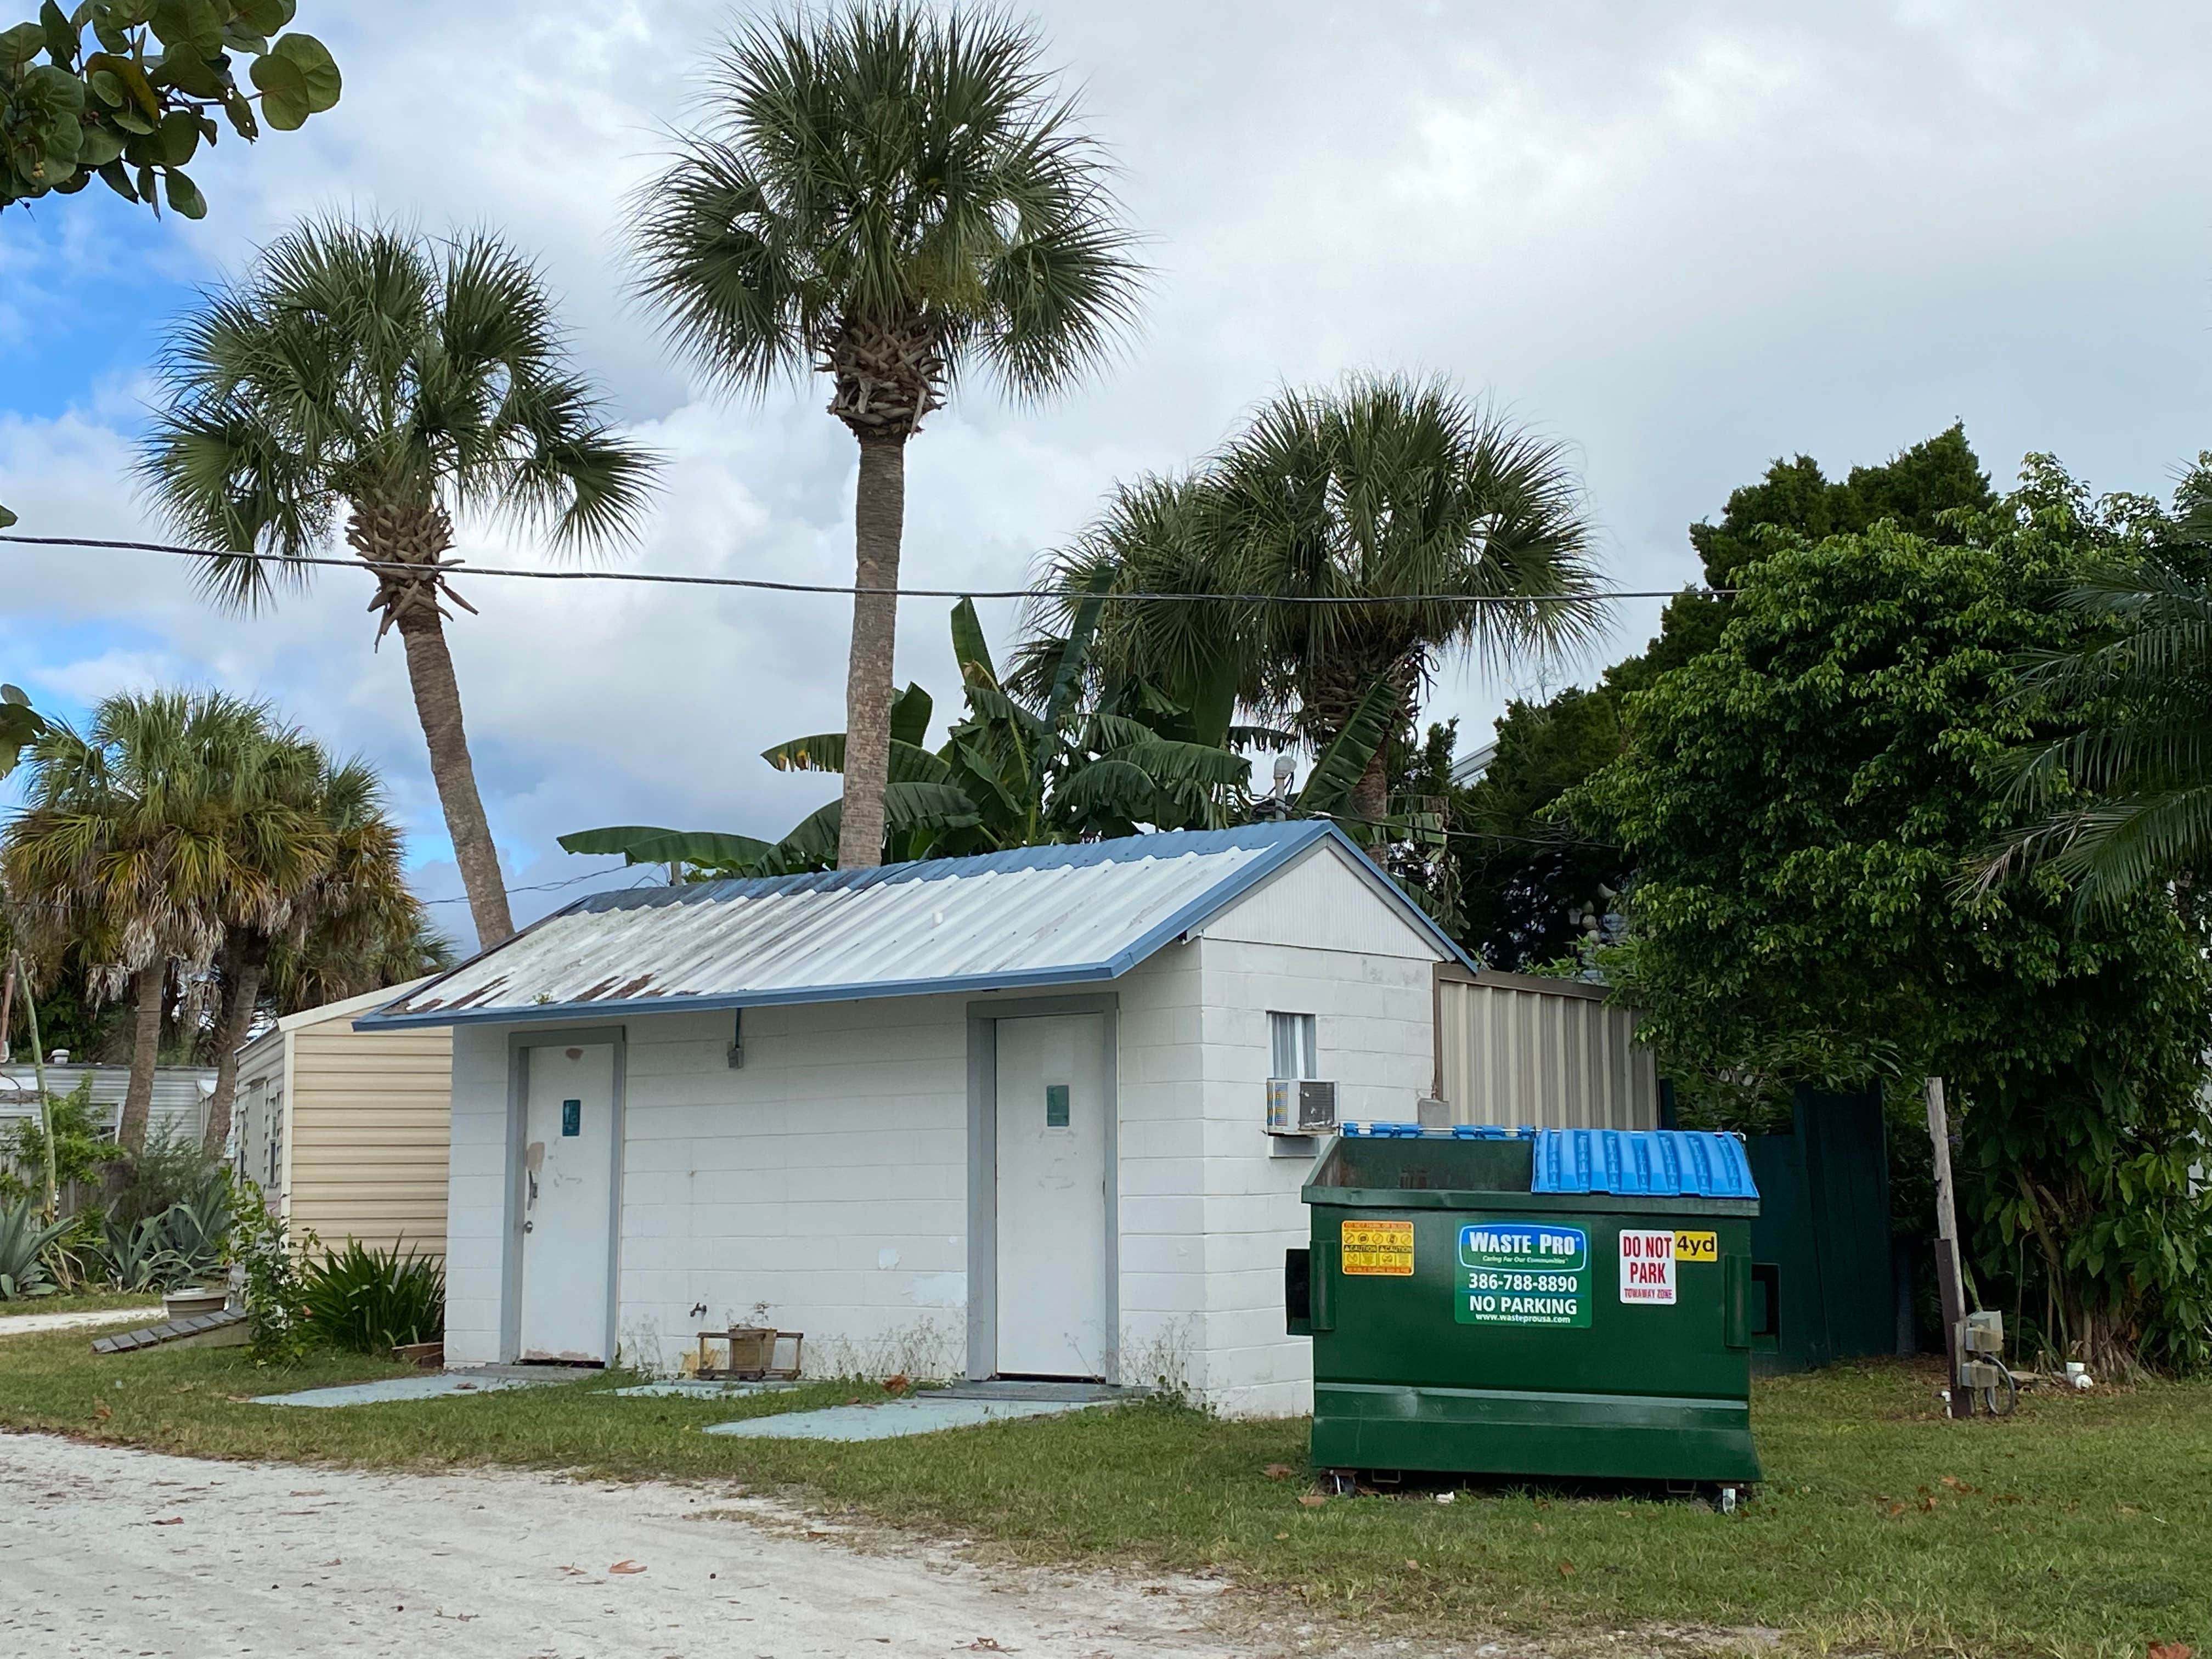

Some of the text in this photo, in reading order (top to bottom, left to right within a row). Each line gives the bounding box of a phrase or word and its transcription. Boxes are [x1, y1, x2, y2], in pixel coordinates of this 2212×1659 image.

[1469, 1232, 1532, 1254] WASTE
[1623, 1236, 1672, 1259] DO NOT
[1677, 1235, 1715, 1256] 4yd
[1482, 1255, 1502, 1263] Caring
[1469, 1273, 1577, 1293] 386-788-8890
[1630, 1262, 1666, 1284] PARK
[1470, 1295, 1577, 1315] NO PARKING
[1475, 1314, 1571, 1324] www.wasteprousa.com
